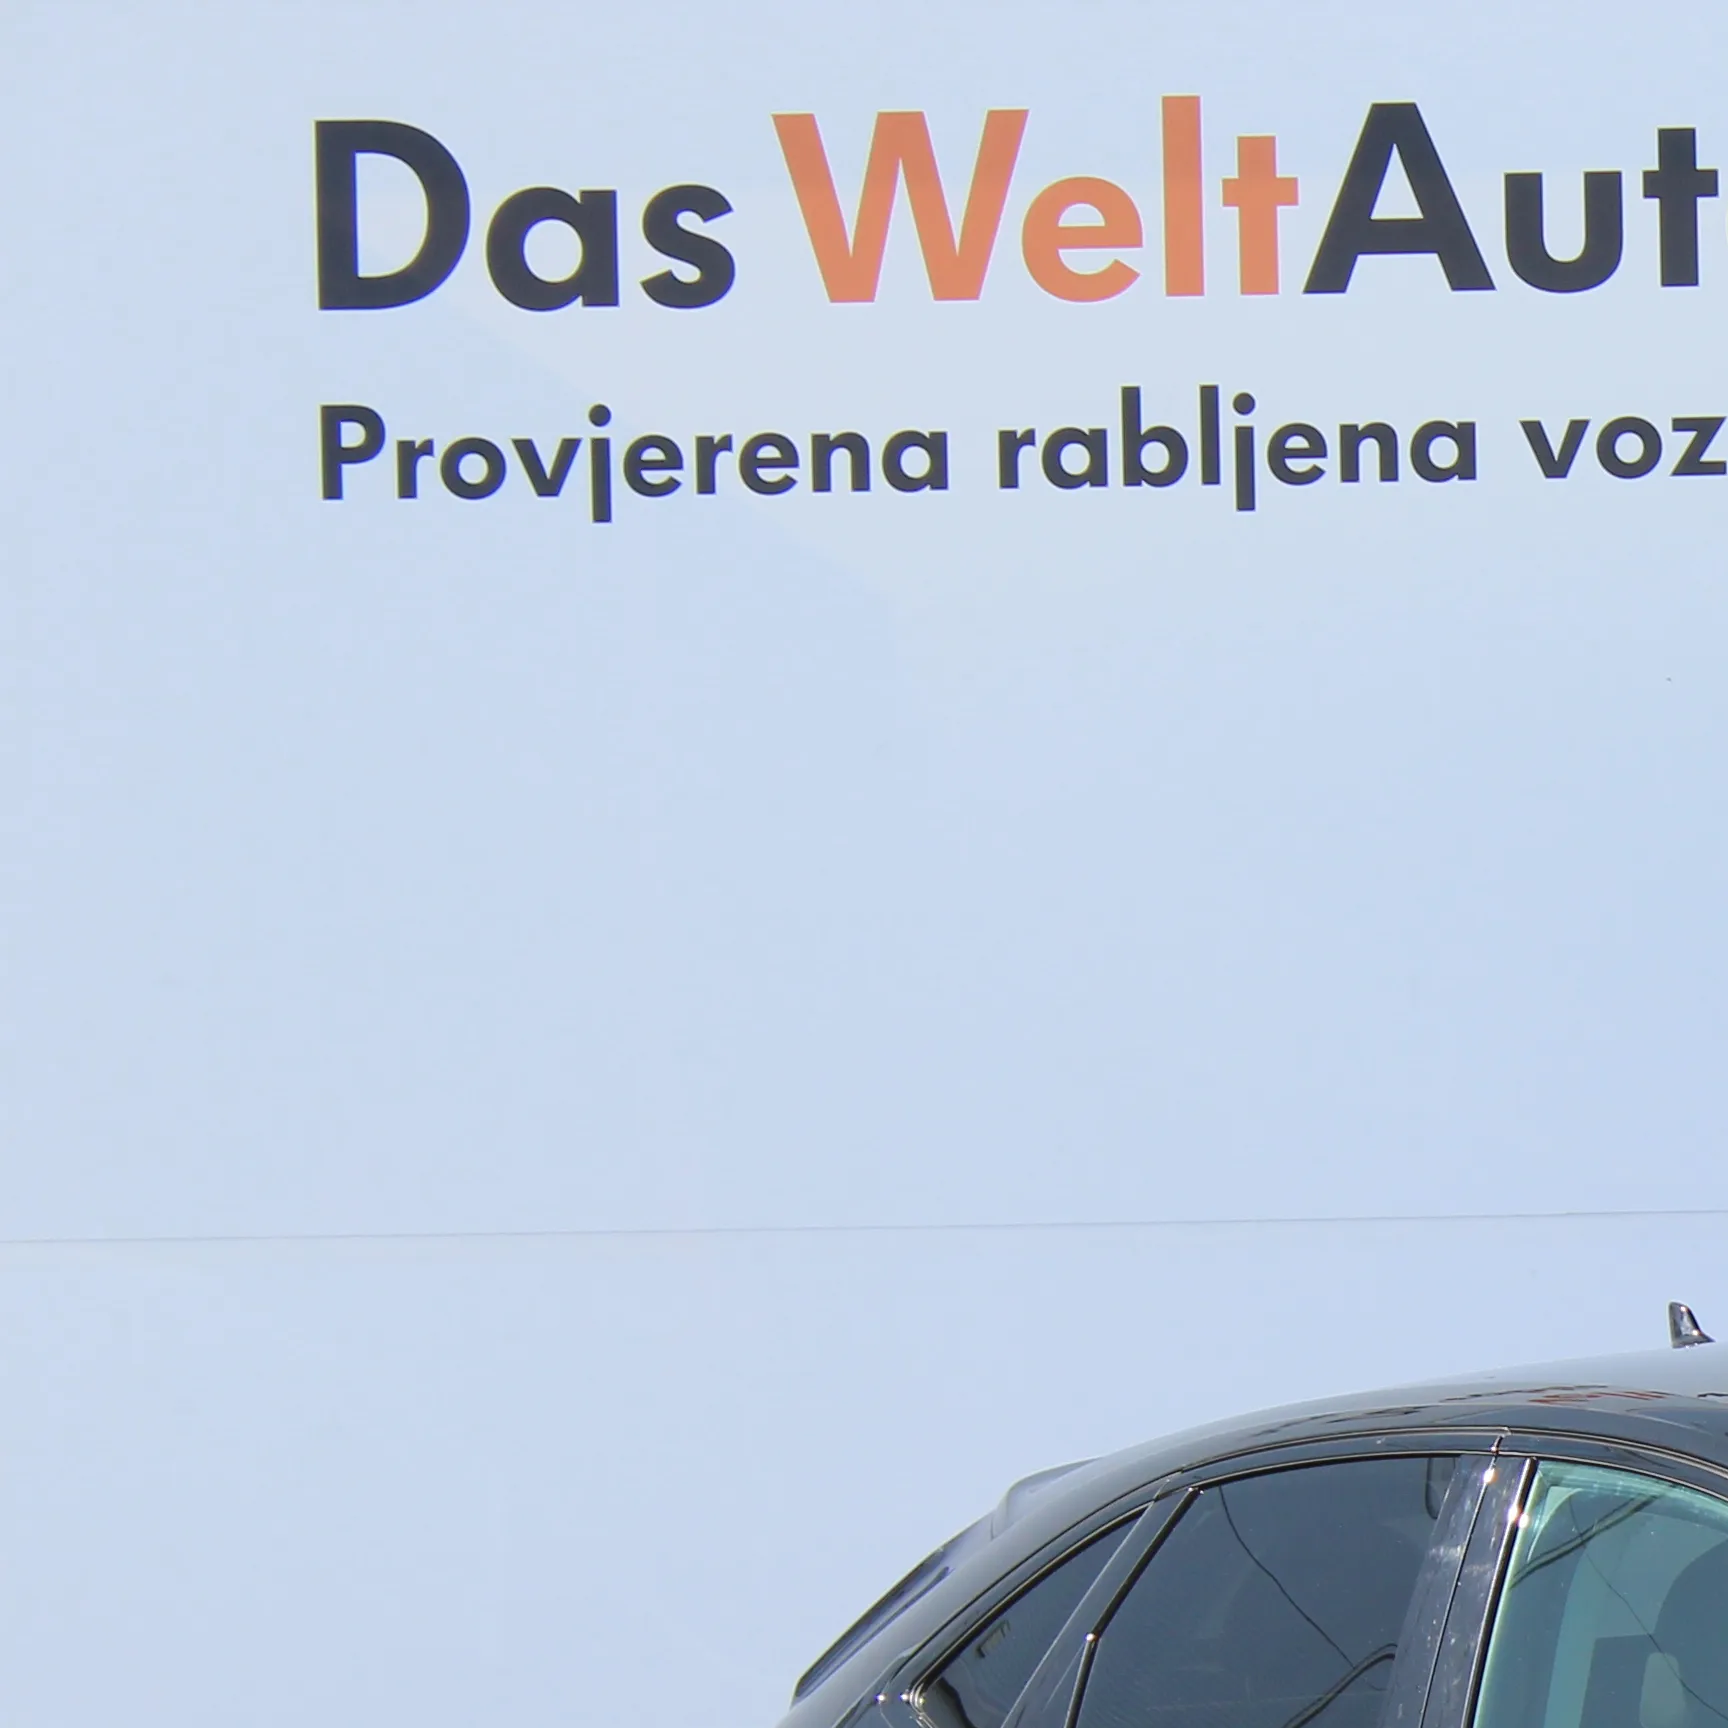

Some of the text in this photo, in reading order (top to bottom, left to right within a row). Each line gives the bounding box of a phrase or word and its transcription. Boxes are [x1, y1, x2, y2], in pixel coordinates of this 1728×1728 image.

[315, 120, 732, 311] Das
[321, 404, 948, 522] Provjerena
[999, 385, 1477, 511] rabljena
